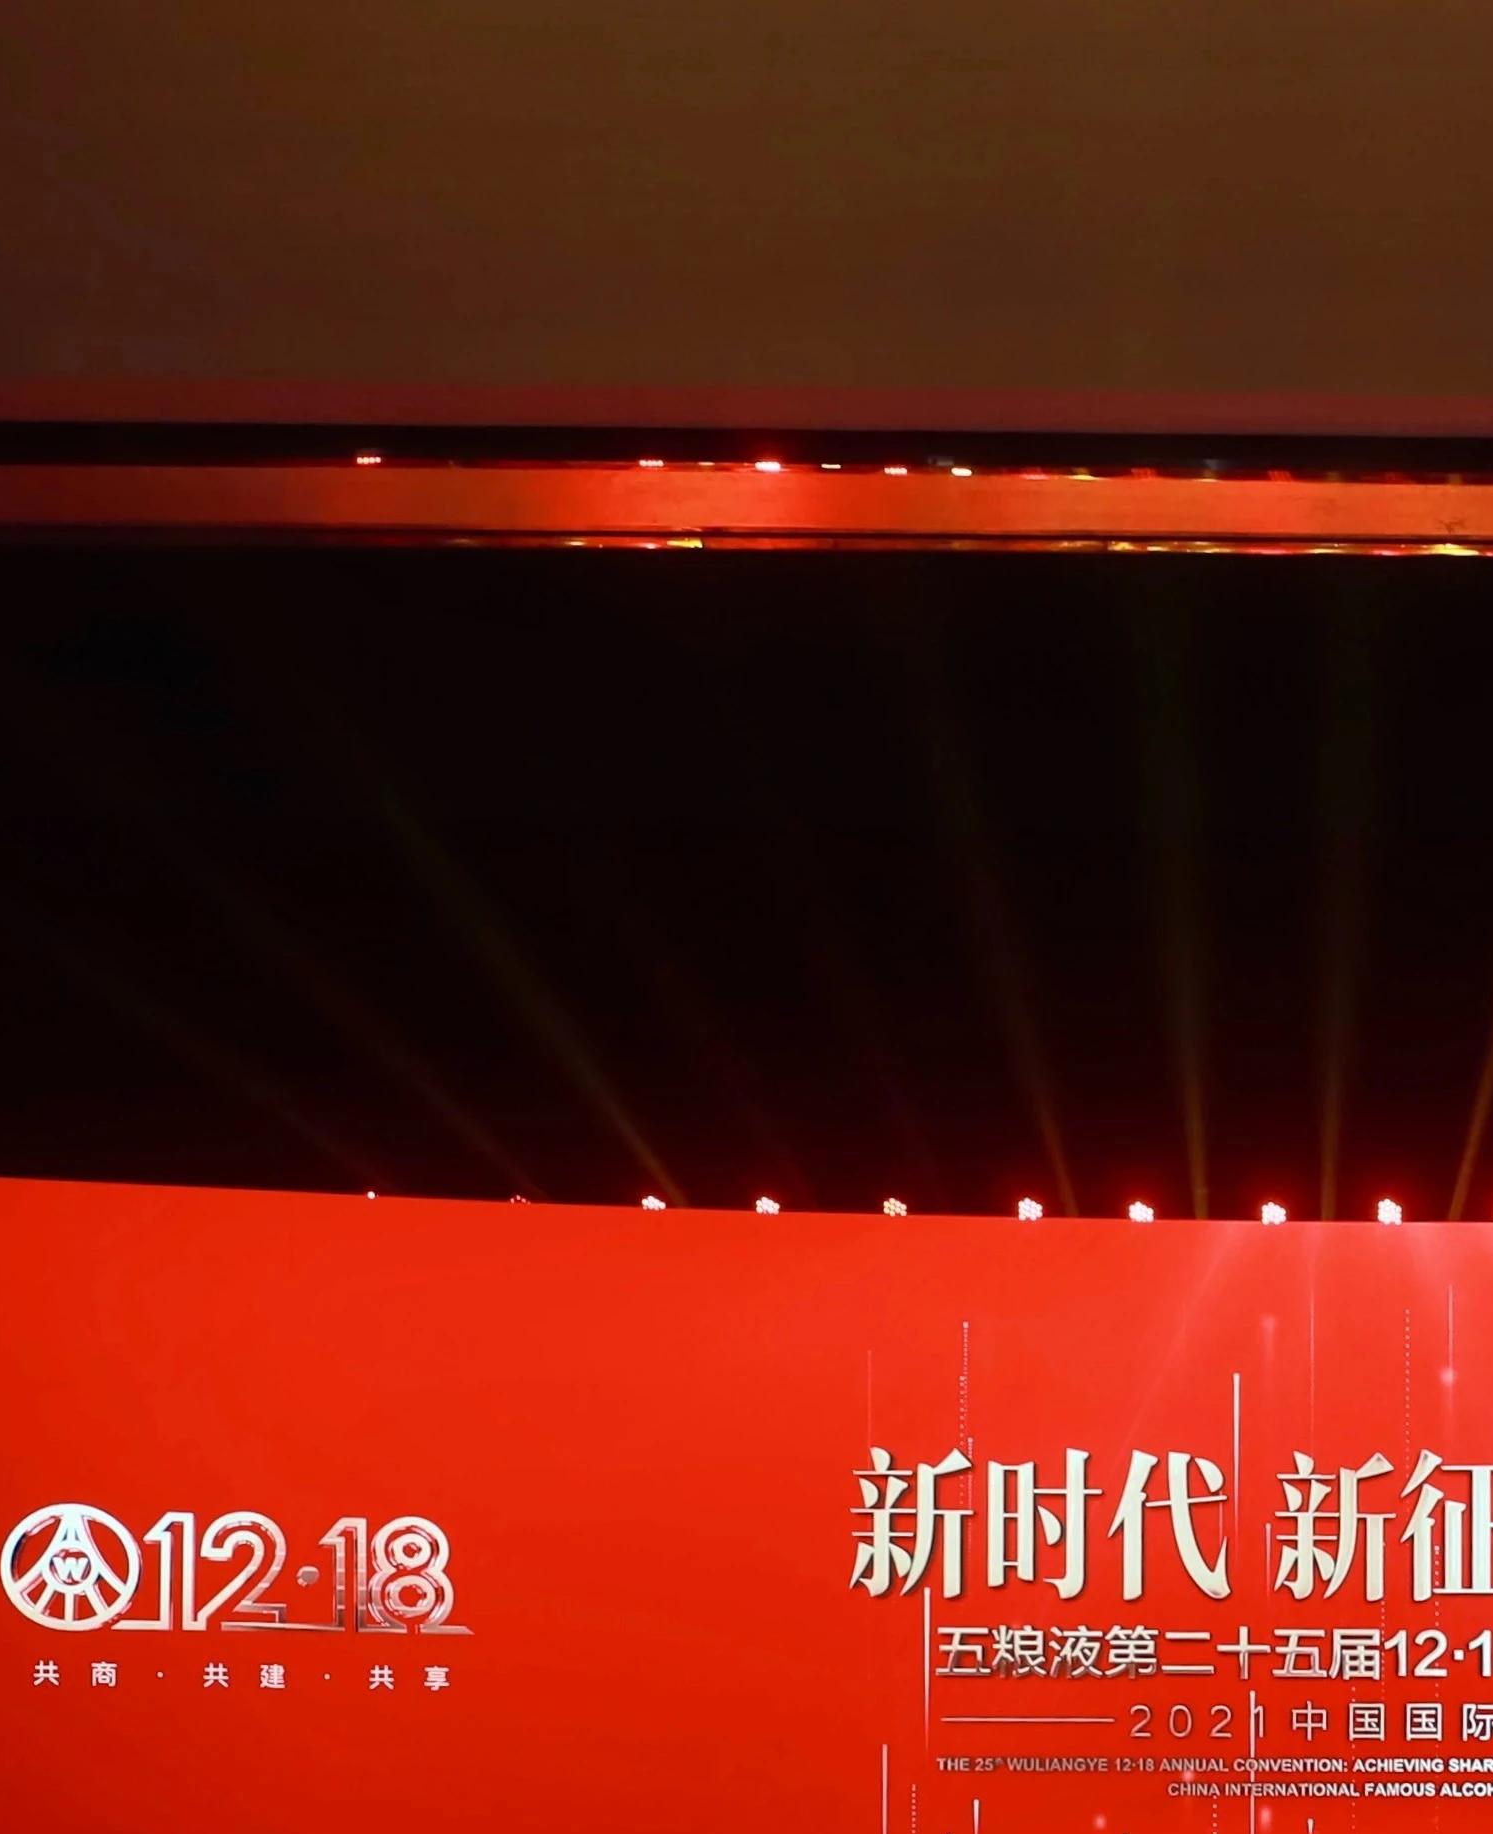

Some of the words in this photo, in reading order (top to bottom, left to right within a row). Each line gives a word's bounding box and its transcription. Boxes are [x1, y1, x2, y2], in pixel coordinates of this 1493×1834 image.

[847, 1446, 1229, 1601] 新时代
[936, 1757, 970, 1772] THE
[1006, 1757, 1108, 1772] WULIANGYE
[1159, 1757, 1229, 1772] ANNUAL
[1233, 1757, 1348, 1772] CONVENTION:
[1352, 1757, 1445, 1772] ACHIEVING
[1168, 1783, 1221, 1798] CHINA
[1224, 1783, 1360, 1798] INTERNATIONAL
[1364, 1783, 1436, 1798] FAMOUS
